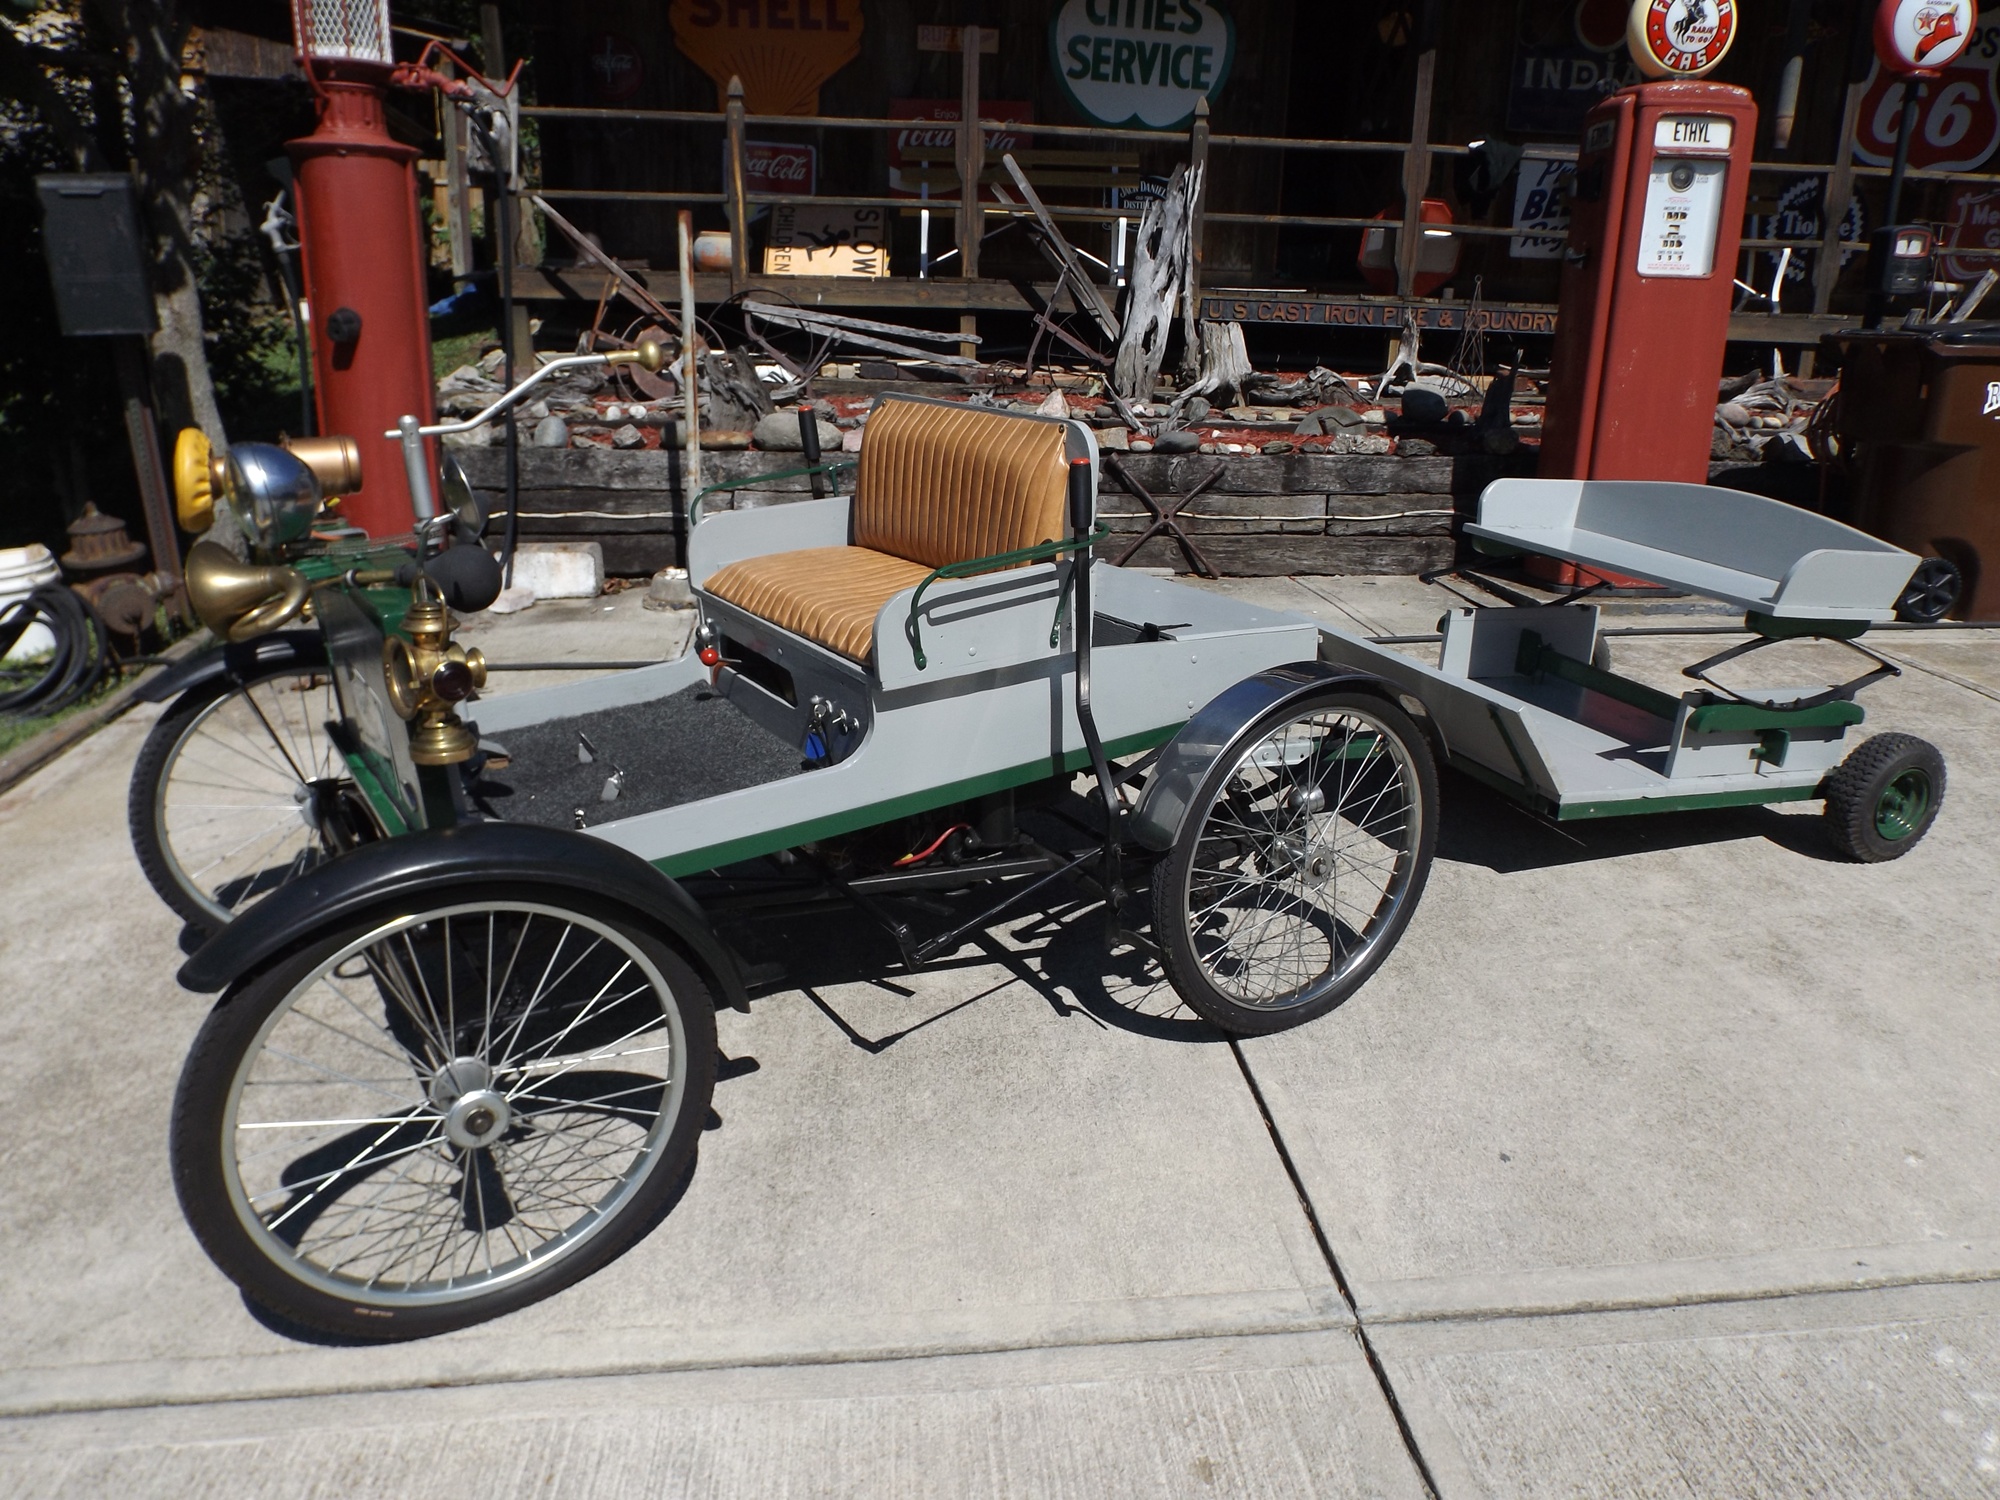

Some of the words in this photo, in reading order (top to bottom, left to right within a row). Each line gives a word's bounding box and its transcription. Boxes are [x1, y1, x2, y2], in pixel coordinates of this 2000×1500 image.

[689, 0, 850, 31] SHELL
[1685, 35, 1695, 43] TO
[1066, 35, 1214, 90] SERVICE
[1662, 48, 1707, 71] GAS
[934, 109, 960, 120] Enjoy
[1872, 81, 1980, 148] 66
[1673, 122, 1711, 143] ETHYL
[773, 203, 796, 273] CHILDREN
[852, 208, 880, 275] SLOW
[1257, 304, 1315, 322] CAST
[1323, 305, 1374, 325] IRON
[1438, 309, 1454, 328] &
